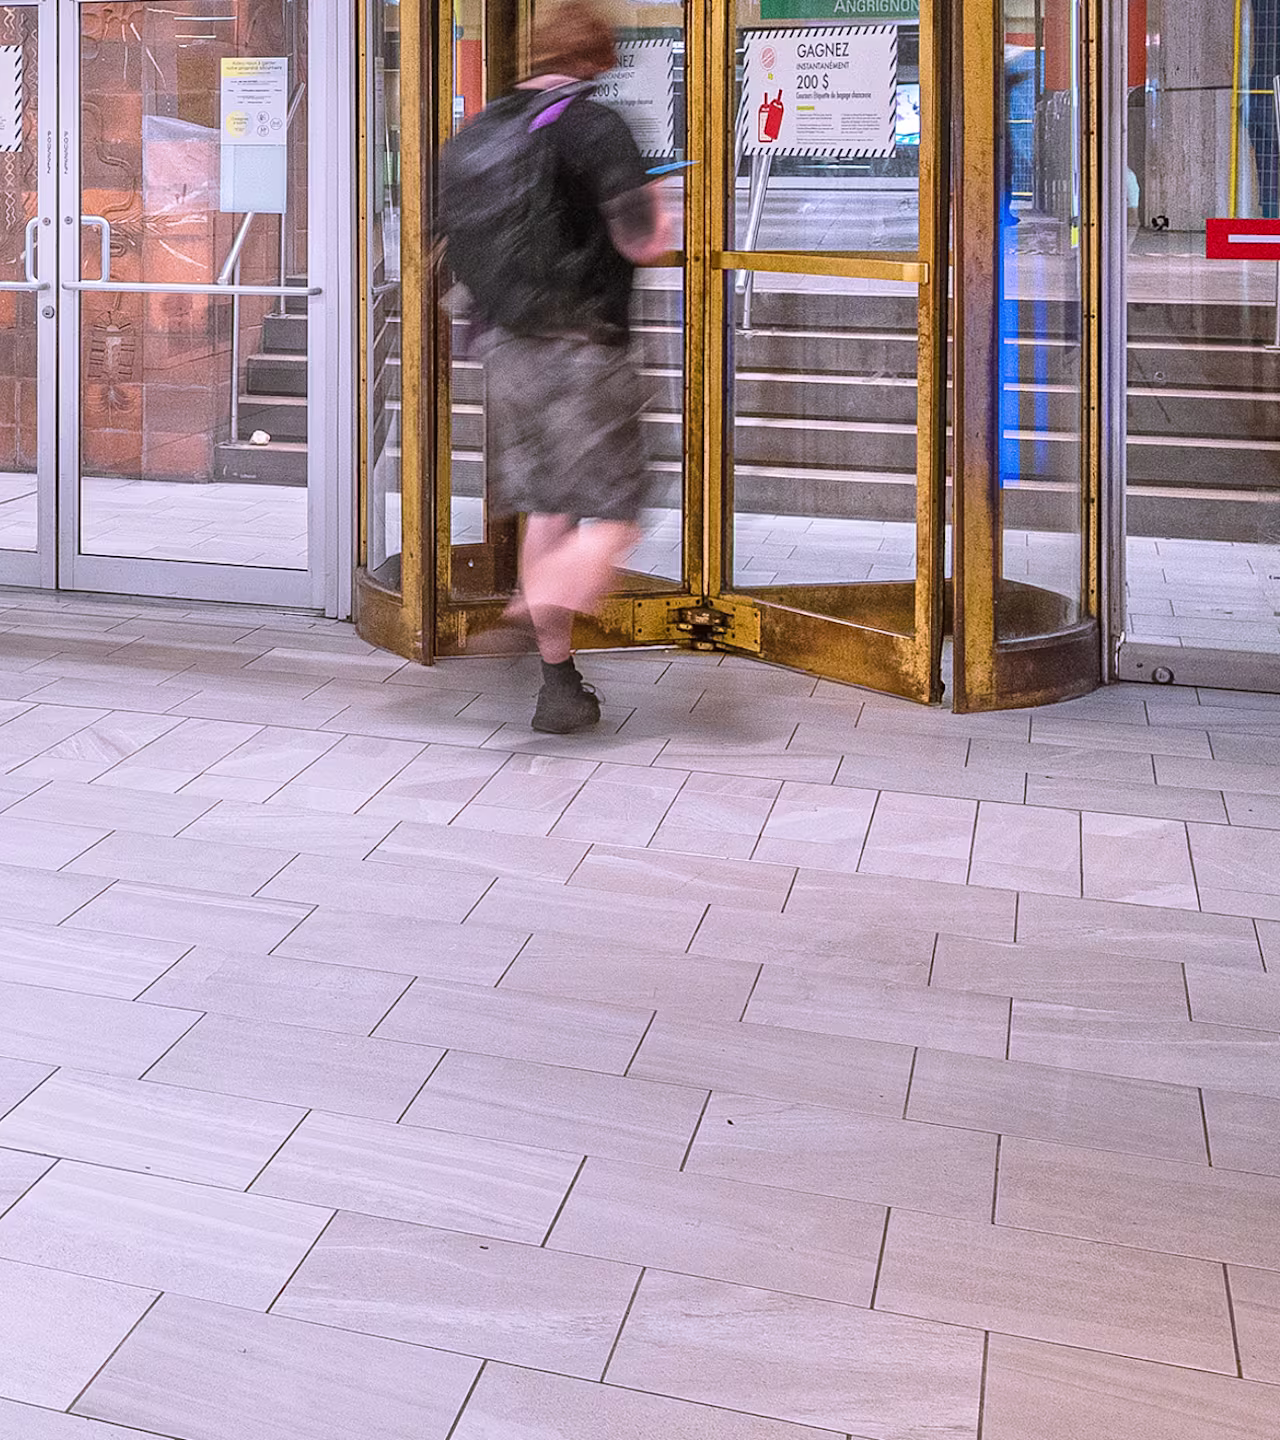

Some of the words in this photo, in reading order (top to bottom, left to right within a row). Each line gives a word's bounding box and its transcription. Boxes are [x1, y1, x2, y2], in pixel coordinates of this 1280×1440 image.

[796, 42, 850, 58] GAGNEZ
[616, 54, 635, 68] NEZ
[796, 62, 850, 71] INSTANTANÉMENT
[613, 82, 619, 98] $
[796, 74, 819, 90] 200
[822, 73, 829, 91] $
